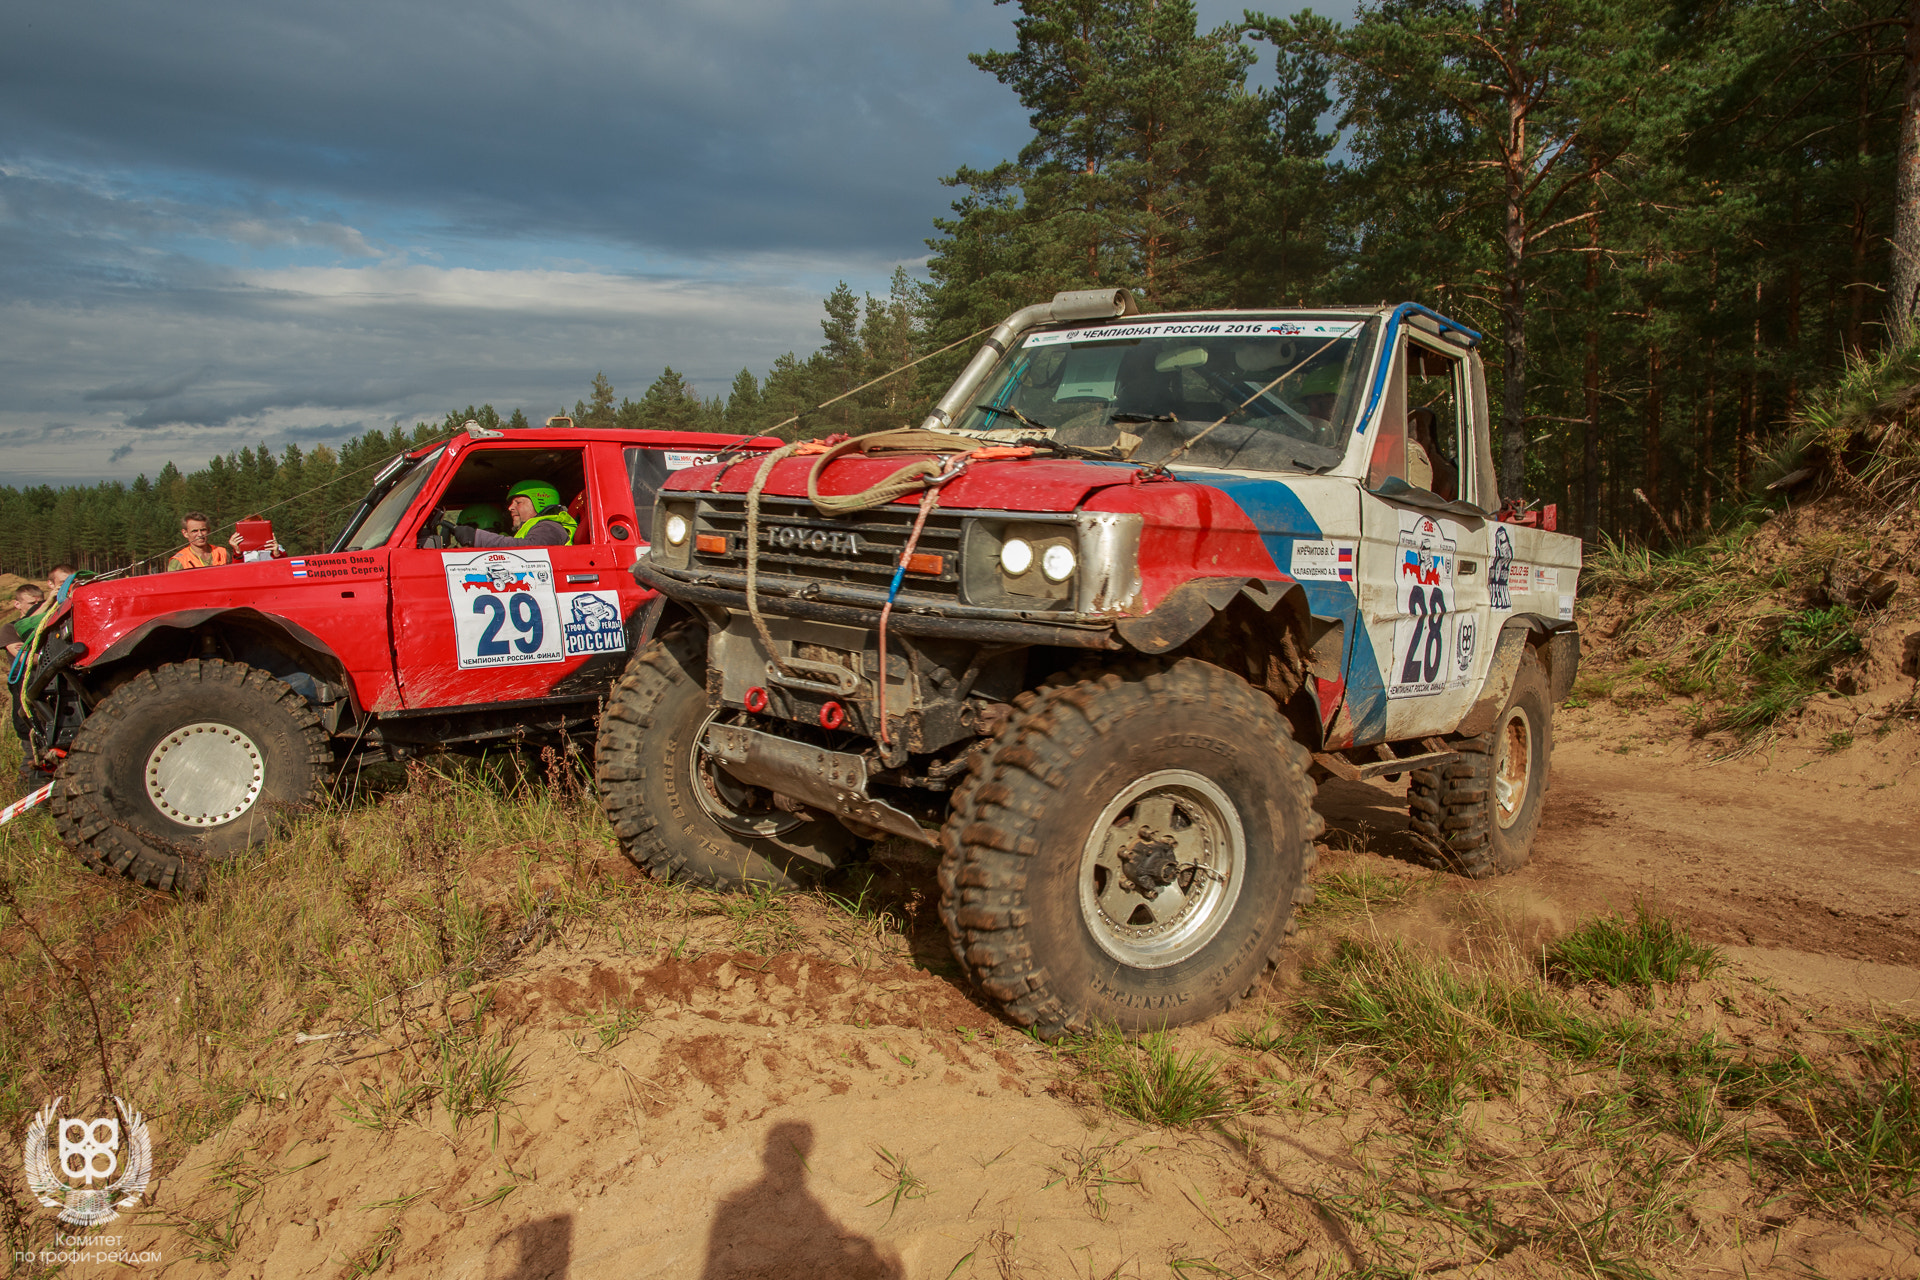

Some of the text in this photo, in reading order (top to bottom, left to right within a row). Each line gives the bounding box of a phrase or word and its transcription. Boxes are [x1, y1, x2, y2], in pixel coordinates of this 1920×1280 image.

[1083, 324, 1262, 338] ЧЕМПИОНАТ РОССИИ 2016
[767, 525, 863, 556] TOYOTA
[305, 556, 375, 568] Каримов Омар
[488, 554, 506, 562] 2016
[306, 565, 385, 578] Сидоров Сергей
[473, 592, 544, 657] 29
[1401, 585, 1447, 684] 28
[569, 630, 623, 652] РОССИИ
[463, 651, 561, 665] ЧЕМПИОНАТ РОССИИ. ФИНАЛ
[663, 738, 730, 861] TSL BOGGER
[1089, 973, 1196, 1010] SWAMPER
